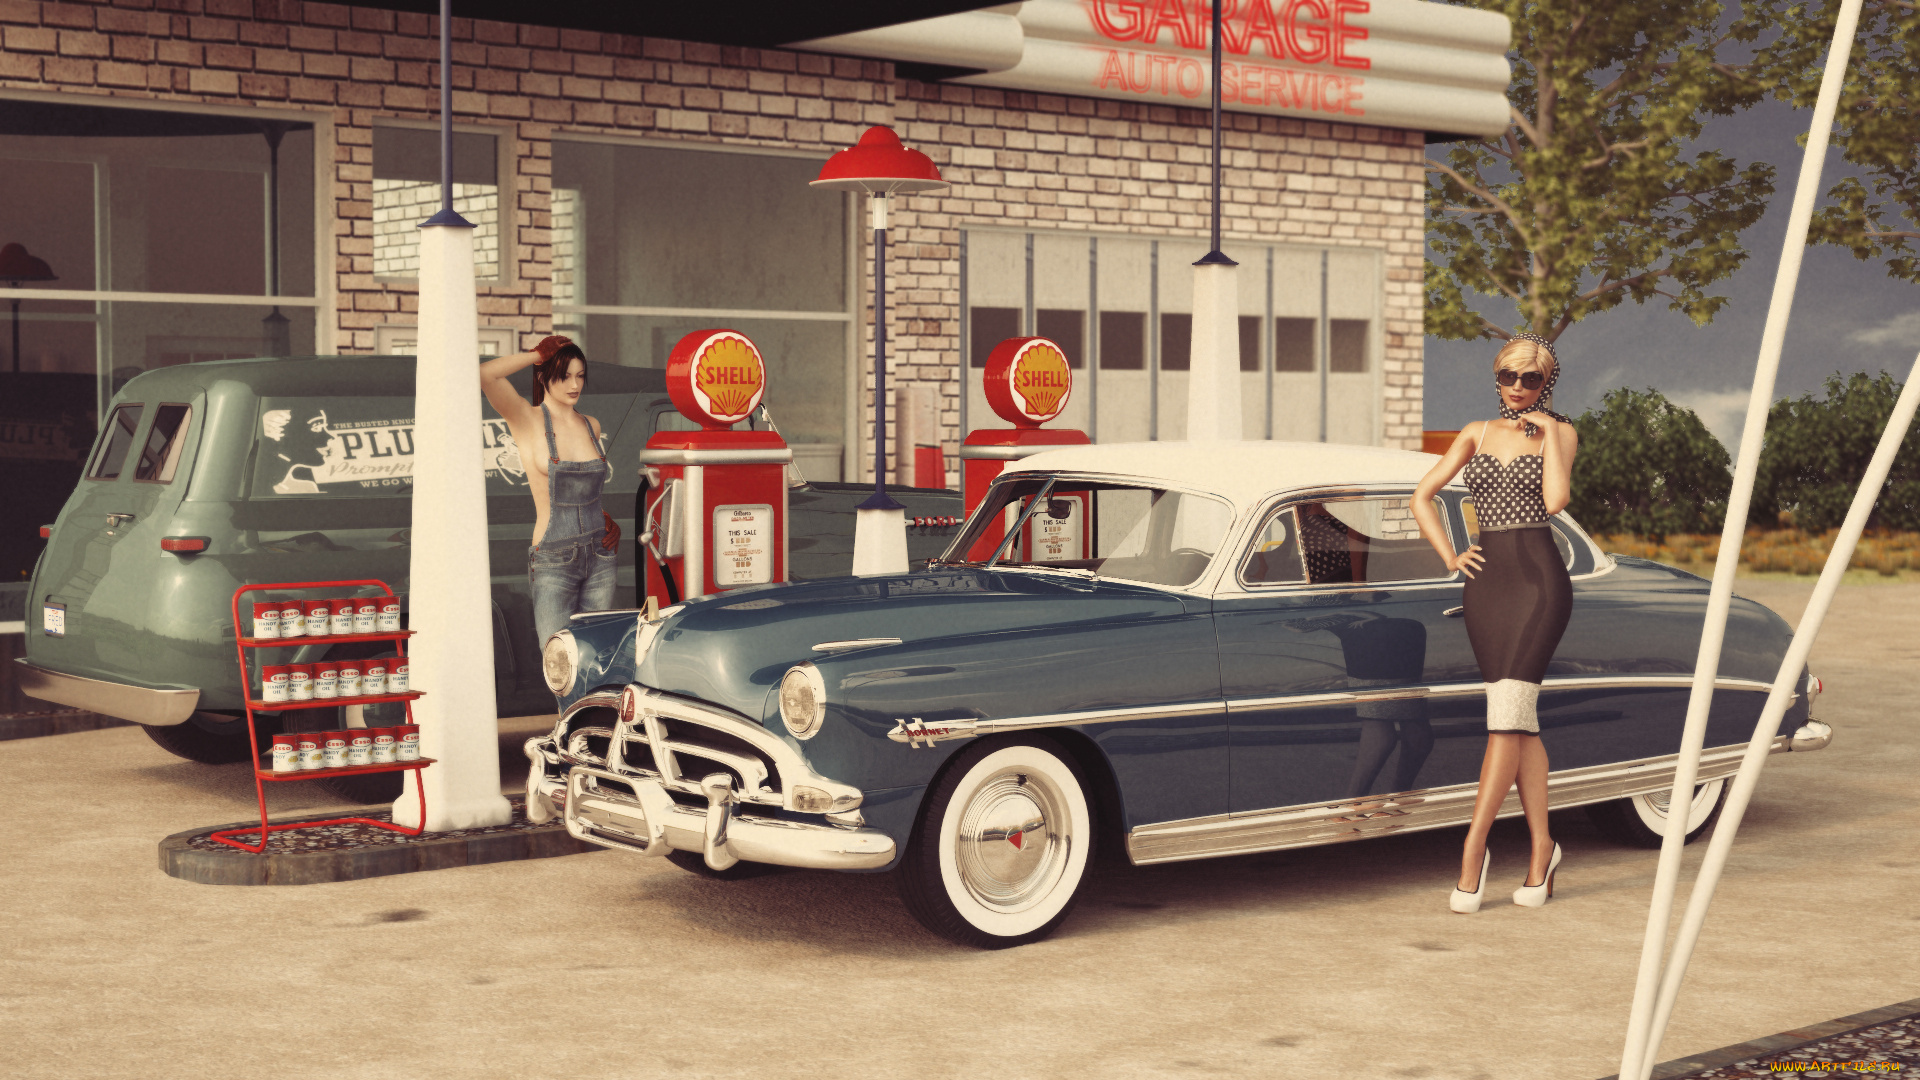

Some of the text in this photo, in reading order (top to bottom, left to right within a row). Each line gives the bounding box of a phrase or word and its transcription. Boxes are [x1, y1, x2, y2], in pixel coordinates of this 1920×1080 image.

[1092, 0, 1371, 70] GARAGE
[1099, 49, 1366, 117] AUTO SERVICE
[705, 366, 756, 385] SHELL
[1022, 370, 1064, 387] SHELL
[334, 422, 353, 430] THE
[355, 420, 390, 428] BUSTED
[360, 480, 379, 488] WE
[381, 478, 400, 486] GO
[913, 515, 957, 527] FORD
[906, 727, 950, 737] HORNET
